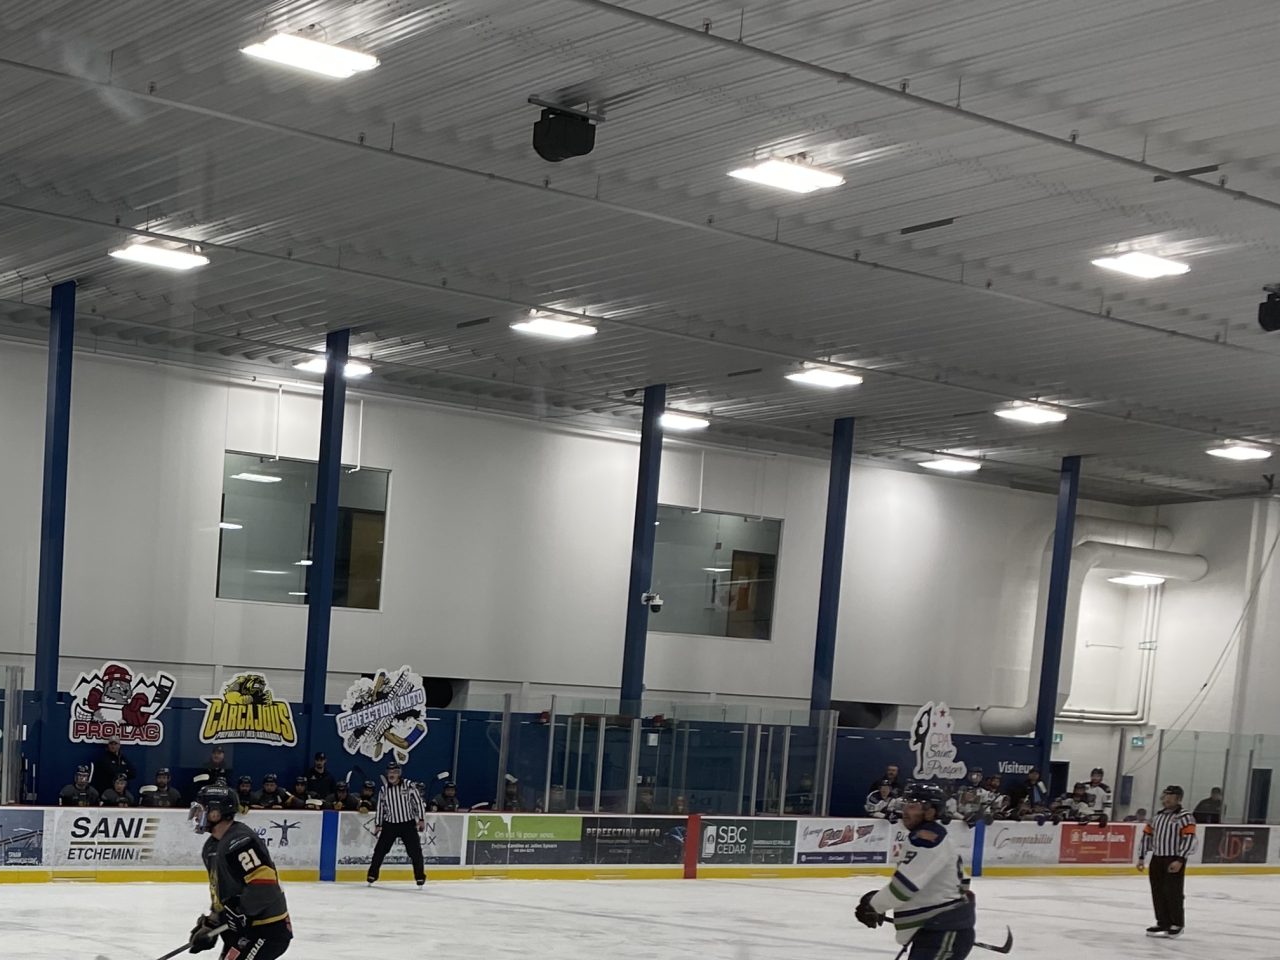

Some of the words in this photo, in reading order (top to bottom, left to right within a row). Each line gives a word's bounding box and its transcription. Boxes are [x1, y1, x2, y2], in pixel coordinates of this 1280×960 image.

[203, 699, 295, 743] CARCAJOUS
[340, 700, 396, 733] PERFECTION
[400, 689, 424, 710] AUTO
[718, 826, 747, 843] SBC
[67, 848, 134, 860] ETCHEMIN
[716, 844, 747, 854] CEDAR
[238, 848, 262, 872] 21
